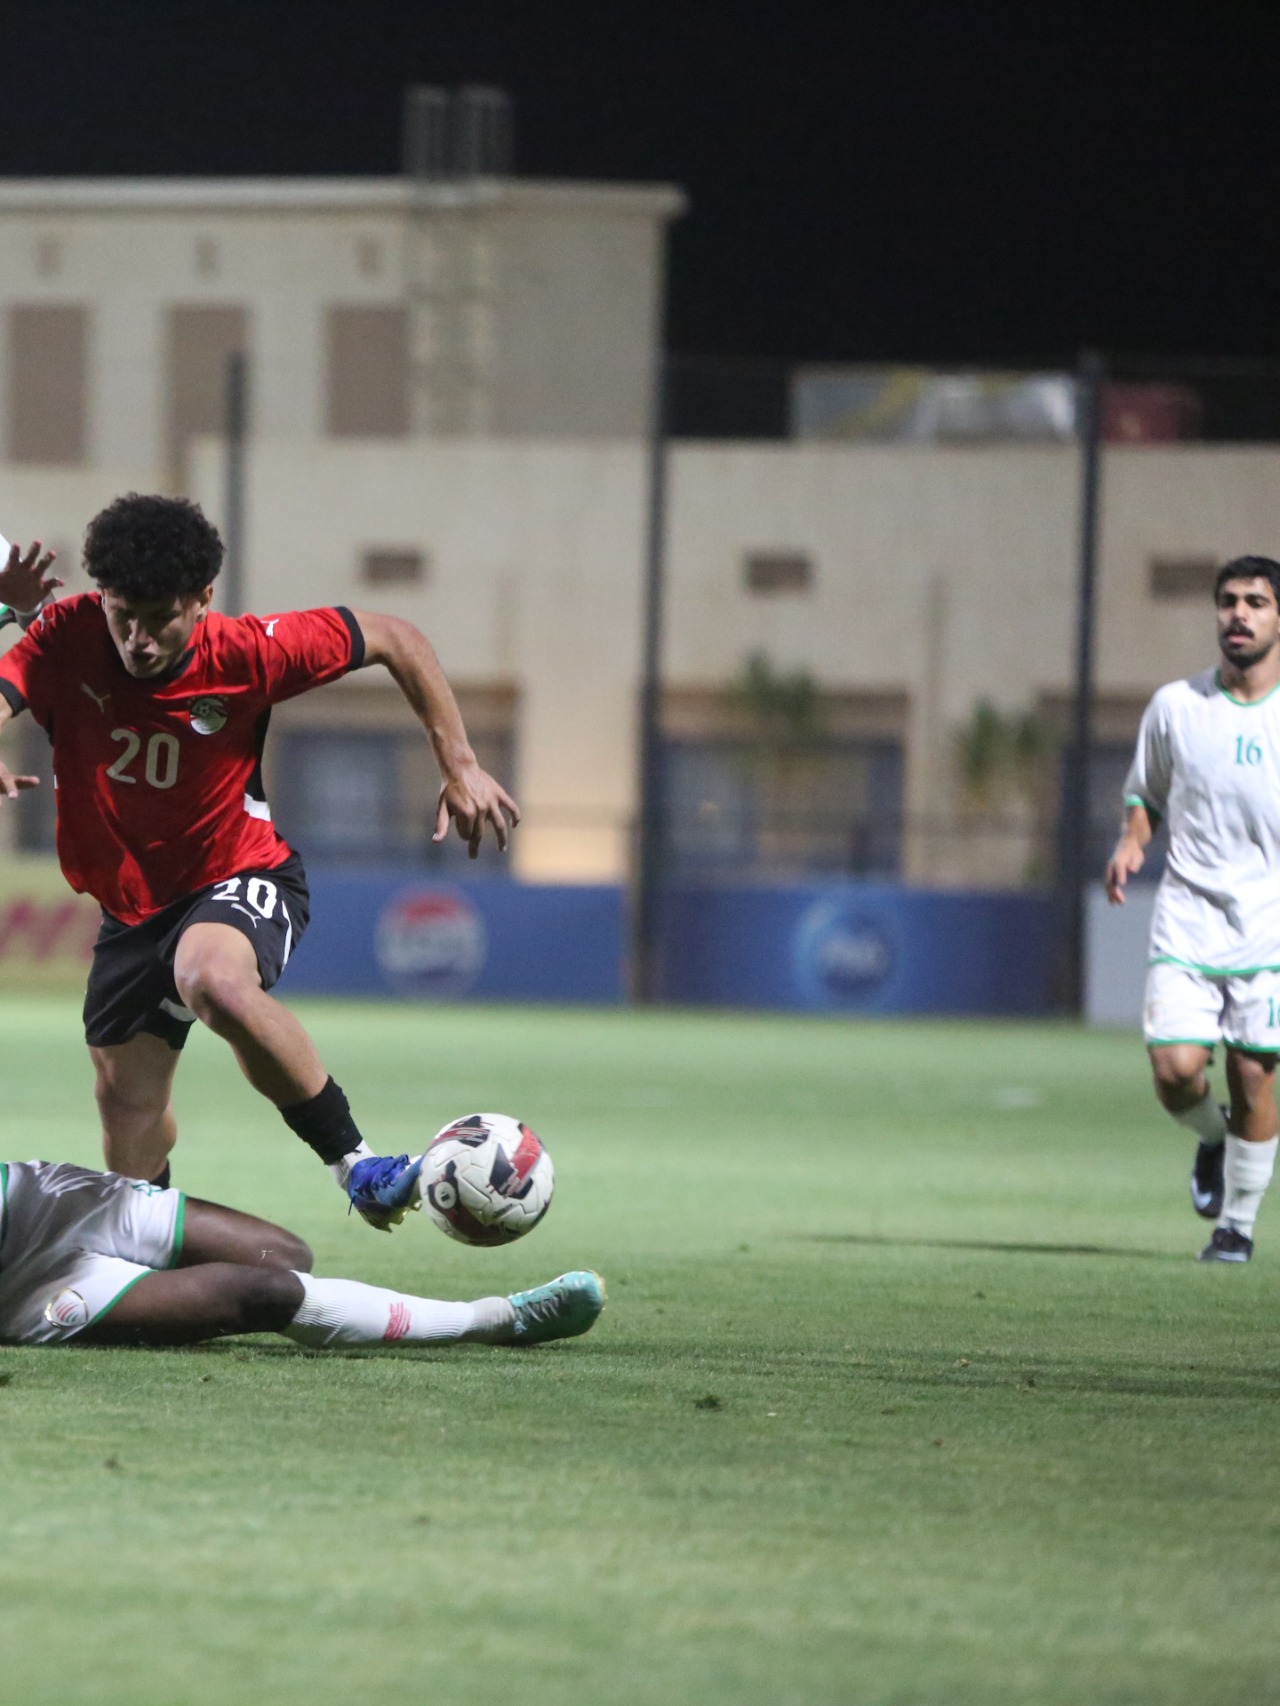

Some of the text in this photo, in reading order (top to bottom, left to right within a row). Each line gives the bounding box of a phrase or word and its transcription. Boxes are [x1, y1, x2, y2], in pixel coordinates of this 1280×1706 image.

[106, 728, 180, 789] 20
[1234, 735, 1262, 766] 16
[211, 877, 277, 919] 20
[1266, 996, 1280, 1028] 1
